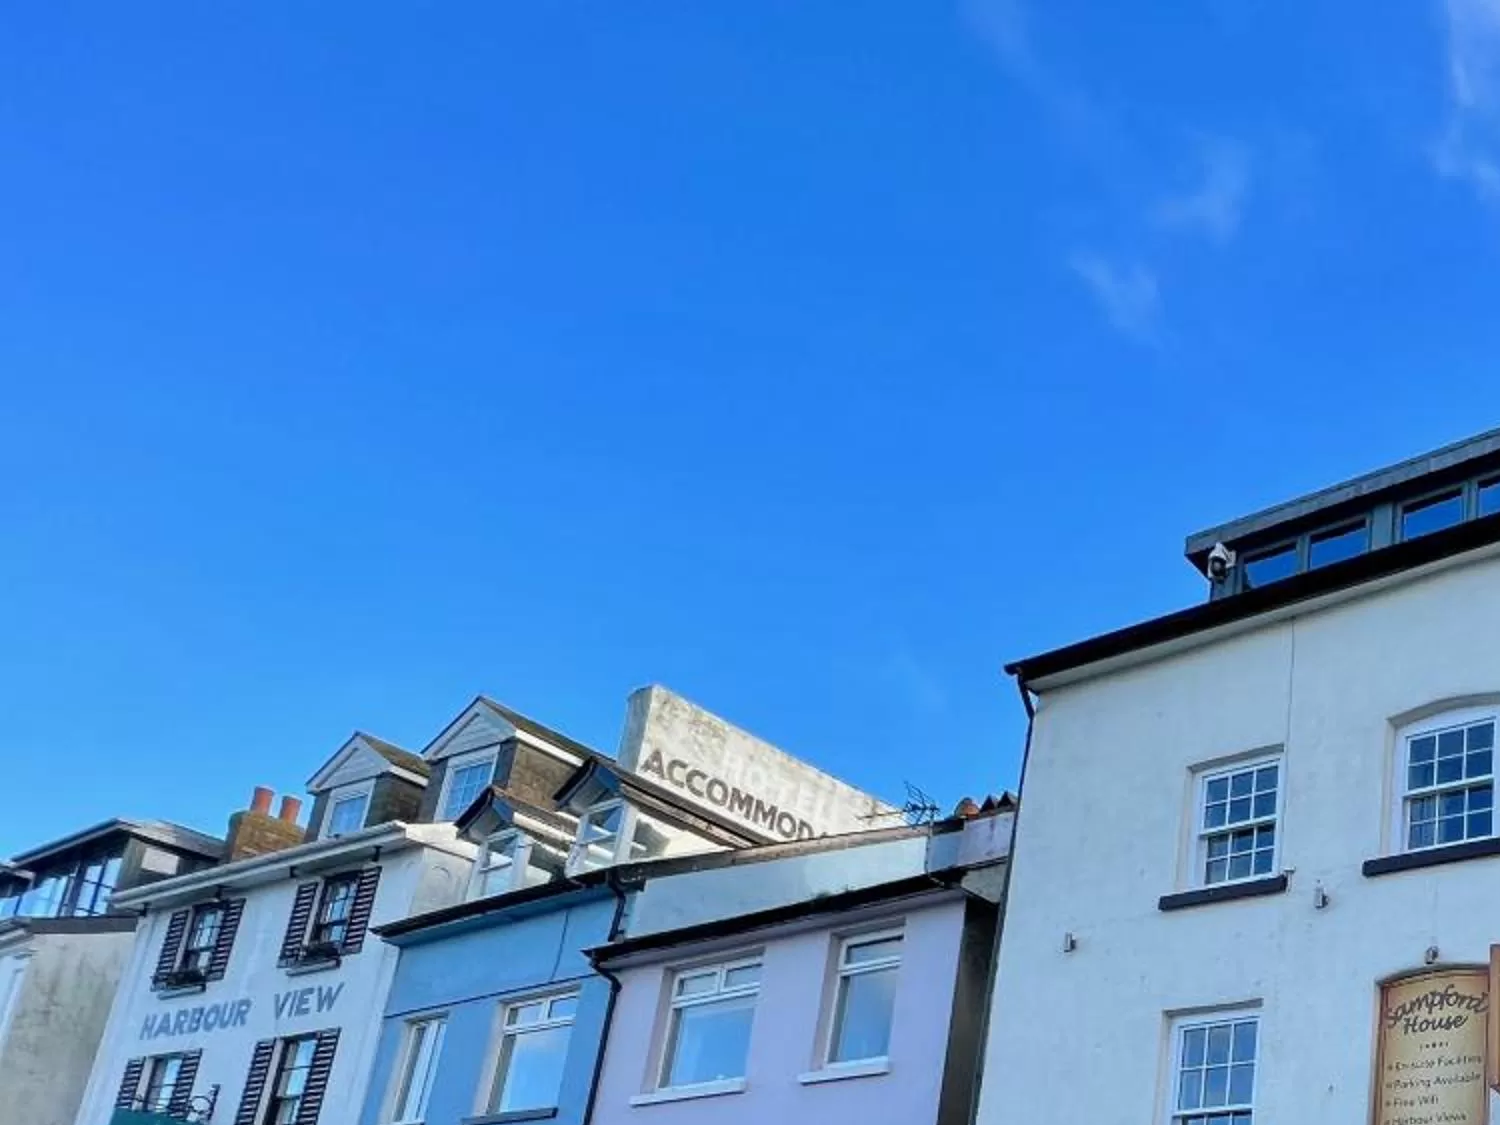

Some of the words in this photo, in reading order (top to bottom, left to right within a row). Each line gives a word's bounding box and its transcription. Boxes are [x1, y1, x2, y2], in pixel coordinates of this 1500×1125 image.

[641, 749, 829, 841] ACCOMMOD
[139, 999, 252, 1041] HARBOUR
[274, 982, 345, 1020] VIEW
[1385, 984, 1489, 1029] Sampford
[1403, 1015, 1468, 1035] House
